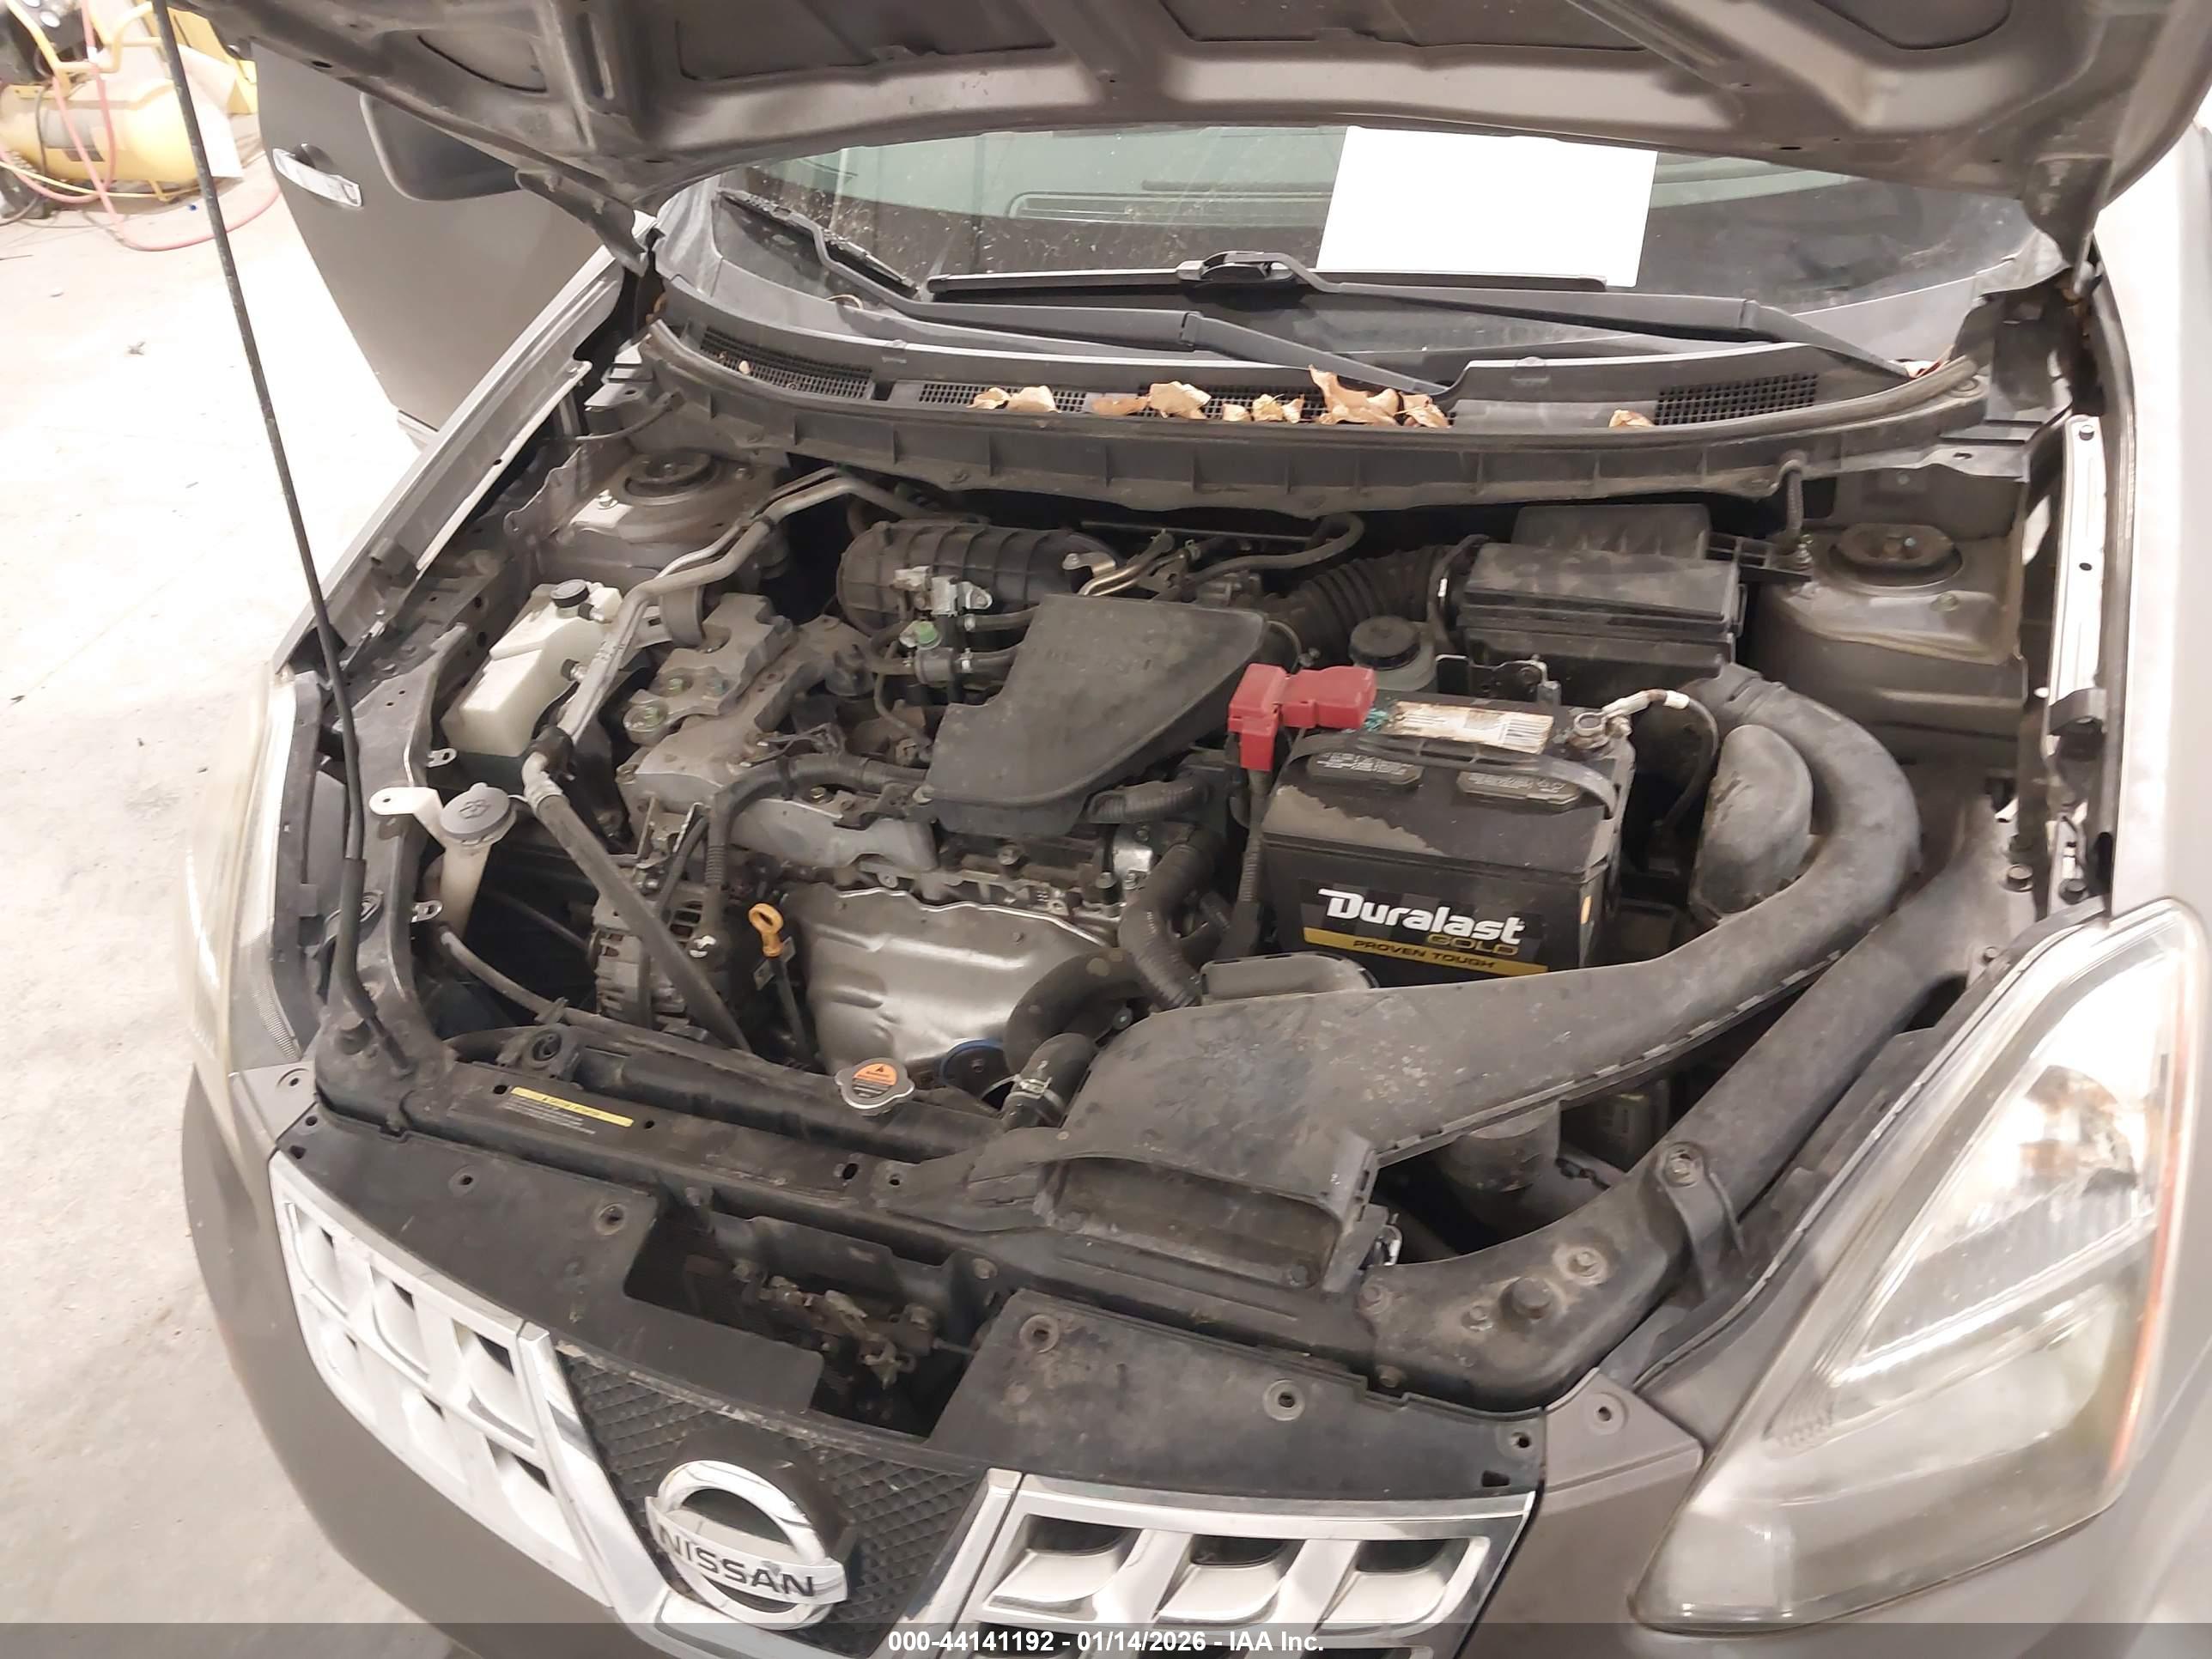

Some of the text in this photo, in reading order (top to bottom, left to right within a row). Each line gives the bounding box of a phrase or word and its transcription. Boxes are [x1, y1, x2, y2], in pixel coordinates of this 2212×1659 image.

[1318, 888, 1525, 945] Duralast
[1352, 939, 1497, 969] PROVEN TOUGH
[1426, 933, 1519, 956] GOLD
[658, 1524, 815, 1597] NISSAN
